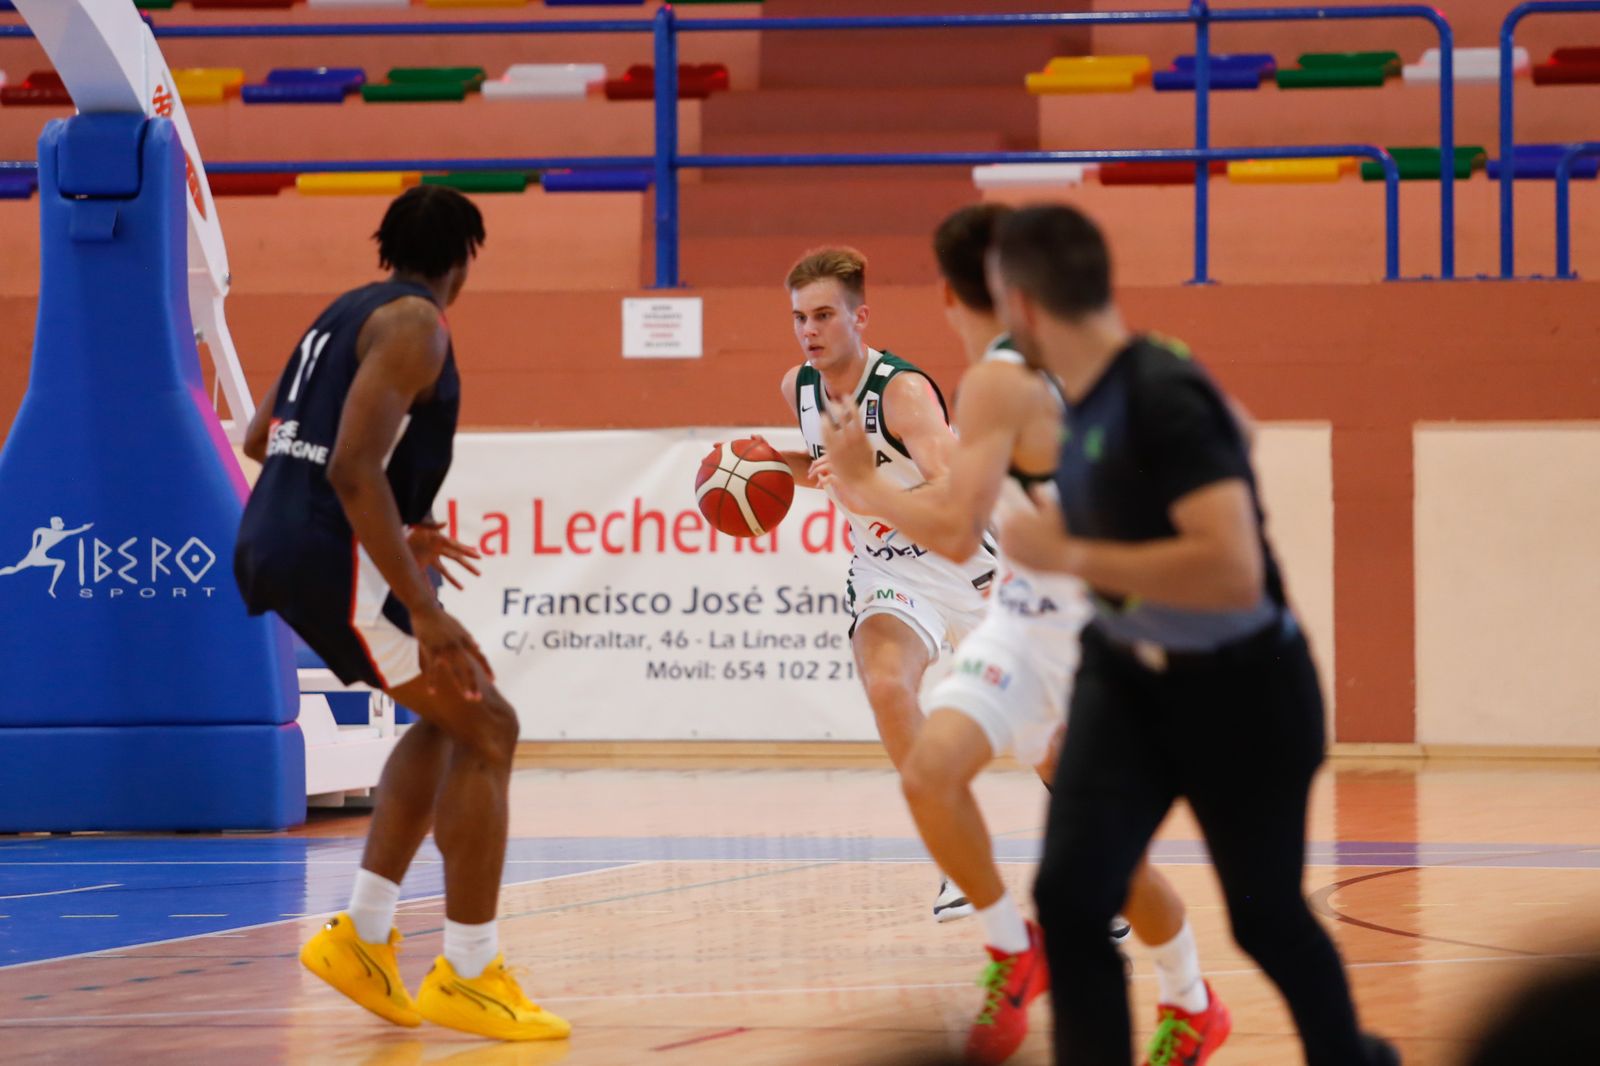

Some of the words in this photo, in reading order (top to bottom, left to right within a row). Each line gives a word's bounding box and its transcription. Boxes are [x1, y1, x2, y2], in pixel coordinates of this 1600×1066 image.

[448, 499, 509, 556] La
[78, 536, 216, 586] IBERO
[79, 587, 216, 599] SPORT
[502, 585, 671, 616] Francisco
[682, 585, 763, 615] José
[543, 629, 652, 652] Gibraltar,
[660, 630, 689, 650] 46
[709, 630, 735, 649] La
[814, 630, 843, 650] de
[646, 660, 715, 680] Móvil:
[723, 660, 765, 680] 654
[779, 660, 820, 680] 102
